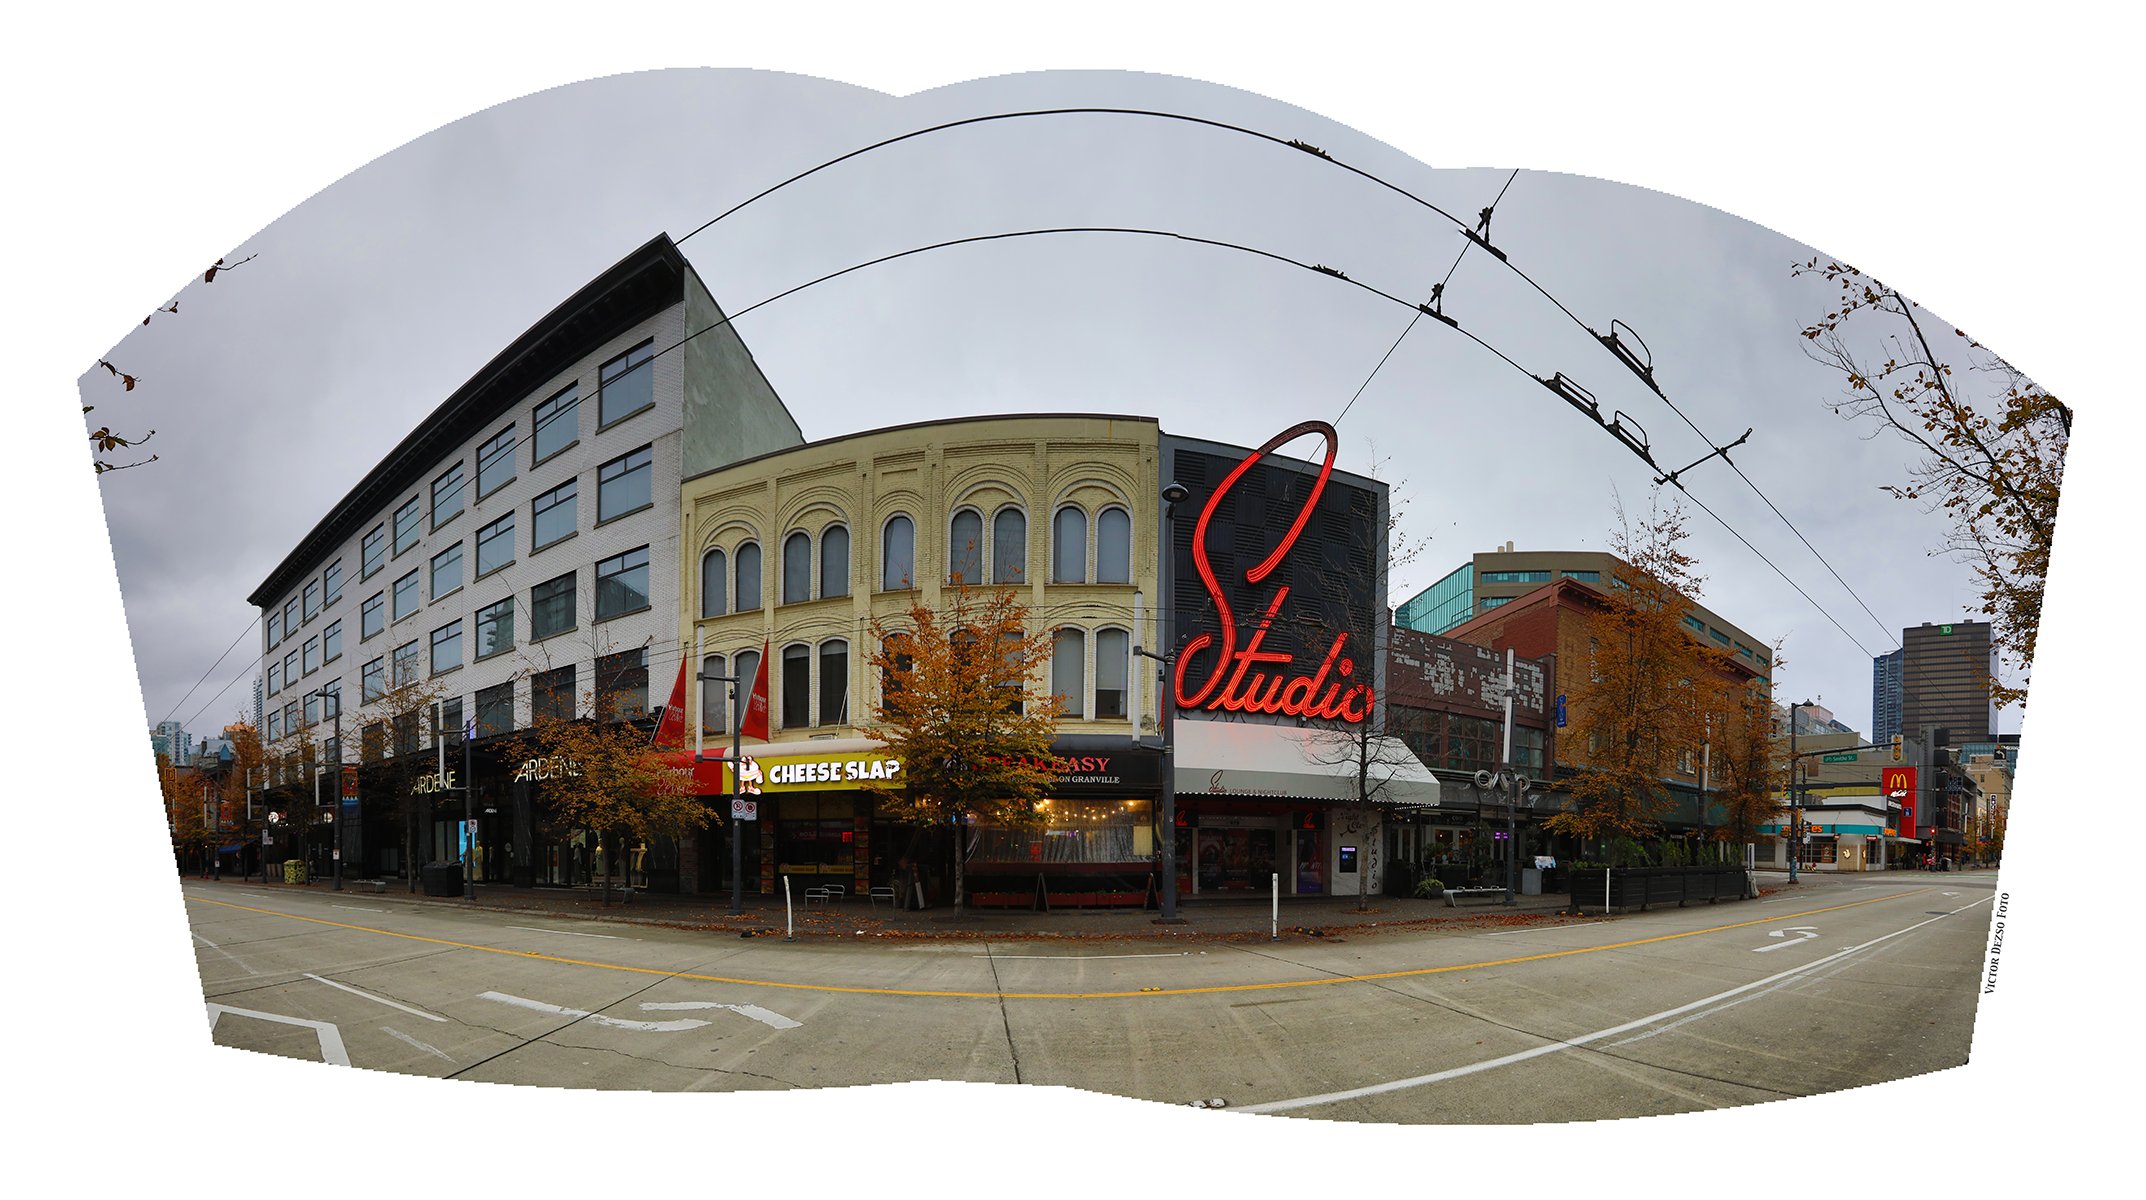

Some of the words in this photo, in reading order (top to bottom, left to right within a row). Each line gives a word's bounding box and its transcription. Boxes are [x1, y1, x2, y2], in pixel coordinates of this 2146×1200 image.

[1174, 420, 1375, 723] Studio
[1941, 626, 1952, 634] TD
[410, 770, 456, 796] ARDENE
[769, 762, 842, 784] CHEESE
[845, 759, 900, 781] SLAP
[1059, 776, 1071, 784] ON
[1072, 776, 1121, 785] GRANVILLE
